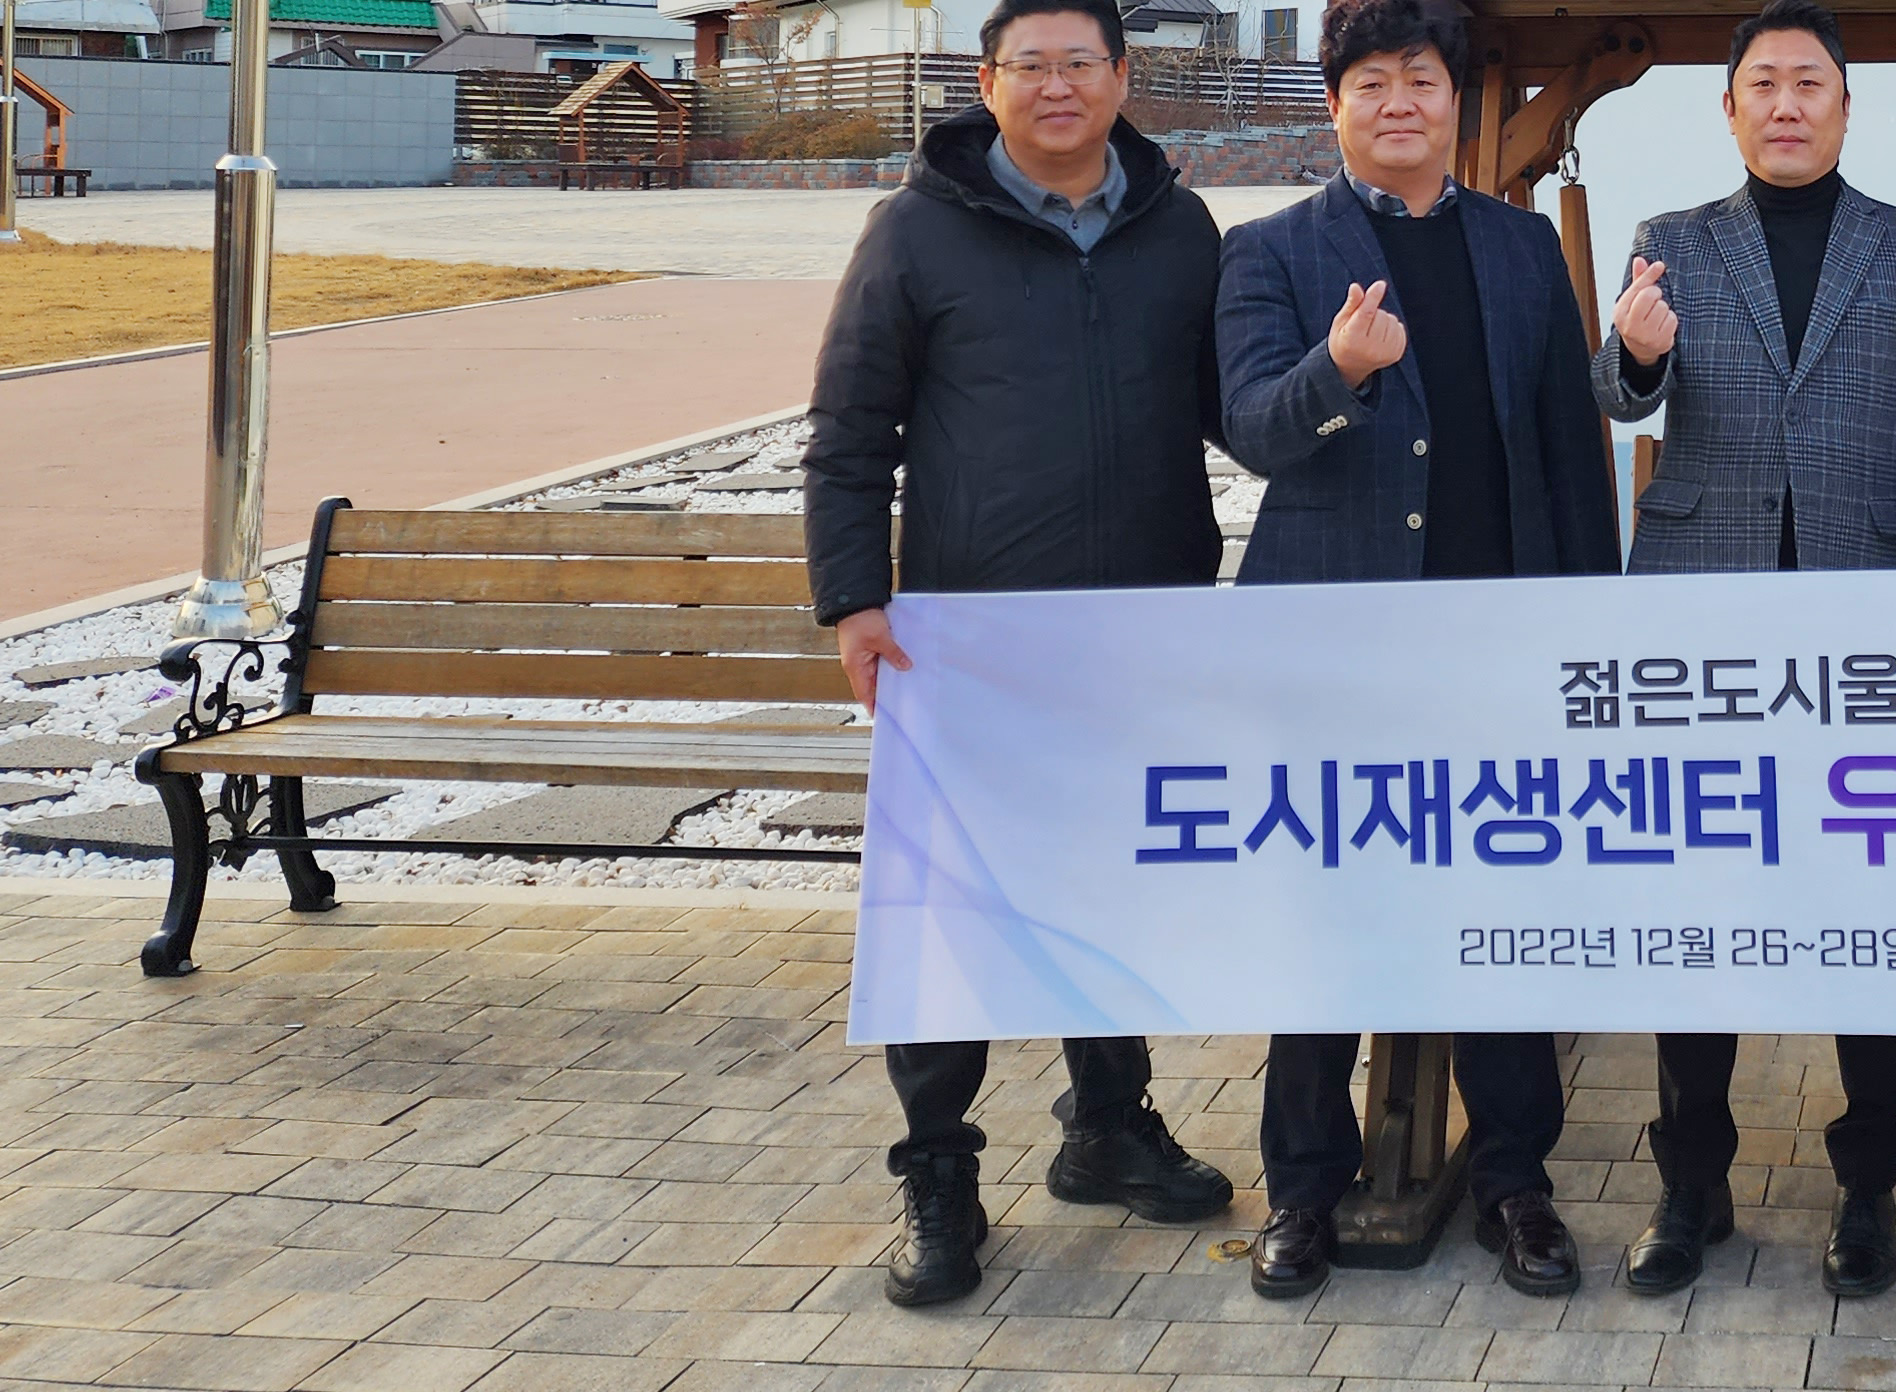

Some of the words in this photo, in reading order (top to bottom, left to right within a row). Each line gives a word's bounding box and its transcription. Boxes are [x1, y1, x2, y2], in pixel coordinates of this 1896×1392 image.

[1135, 755, 1780, 869] 도시재생센터
[1459, 927, 1616, 969] 2022년
[1630, 927, 1716, 969] 12월
